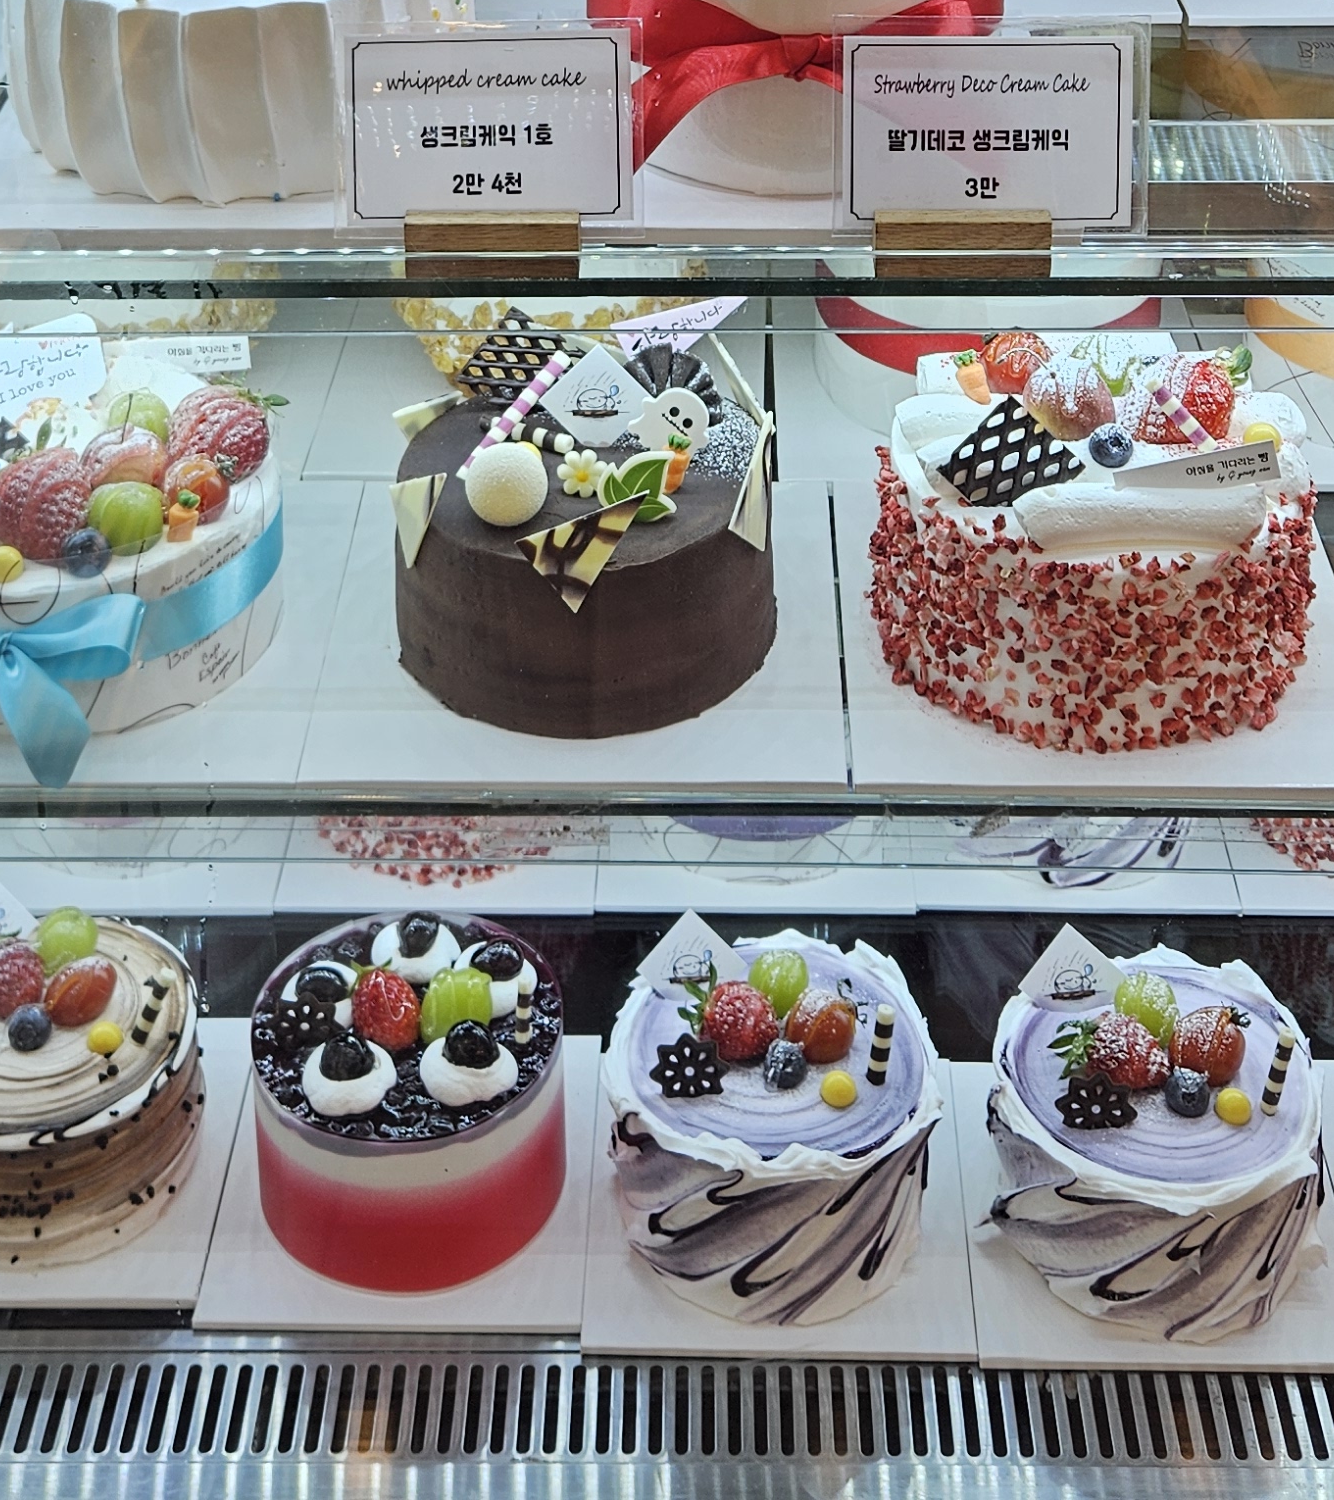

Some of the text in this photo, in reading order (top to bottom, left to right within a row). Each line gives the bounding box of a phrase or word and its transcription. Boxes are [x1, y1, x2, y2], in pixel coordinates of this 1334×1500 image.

[386, 67, 588, 95] whipped cream cake
[873, 72, 1092, 99] Strawberry Deco Cream Cake
[420, 122, 554, 148] 생크림케익 1호
[887, 128, 1070, 153] 딸기데코 생크림케익
[452, 171, 523, 196] 2만 4천
[964, 176, 1001, 200] 3만
[8, 380, 45, 400] love
[48, 368, 77, 388] you
[1185, 451, 1270, 477] 아침을 기다리는 빵
